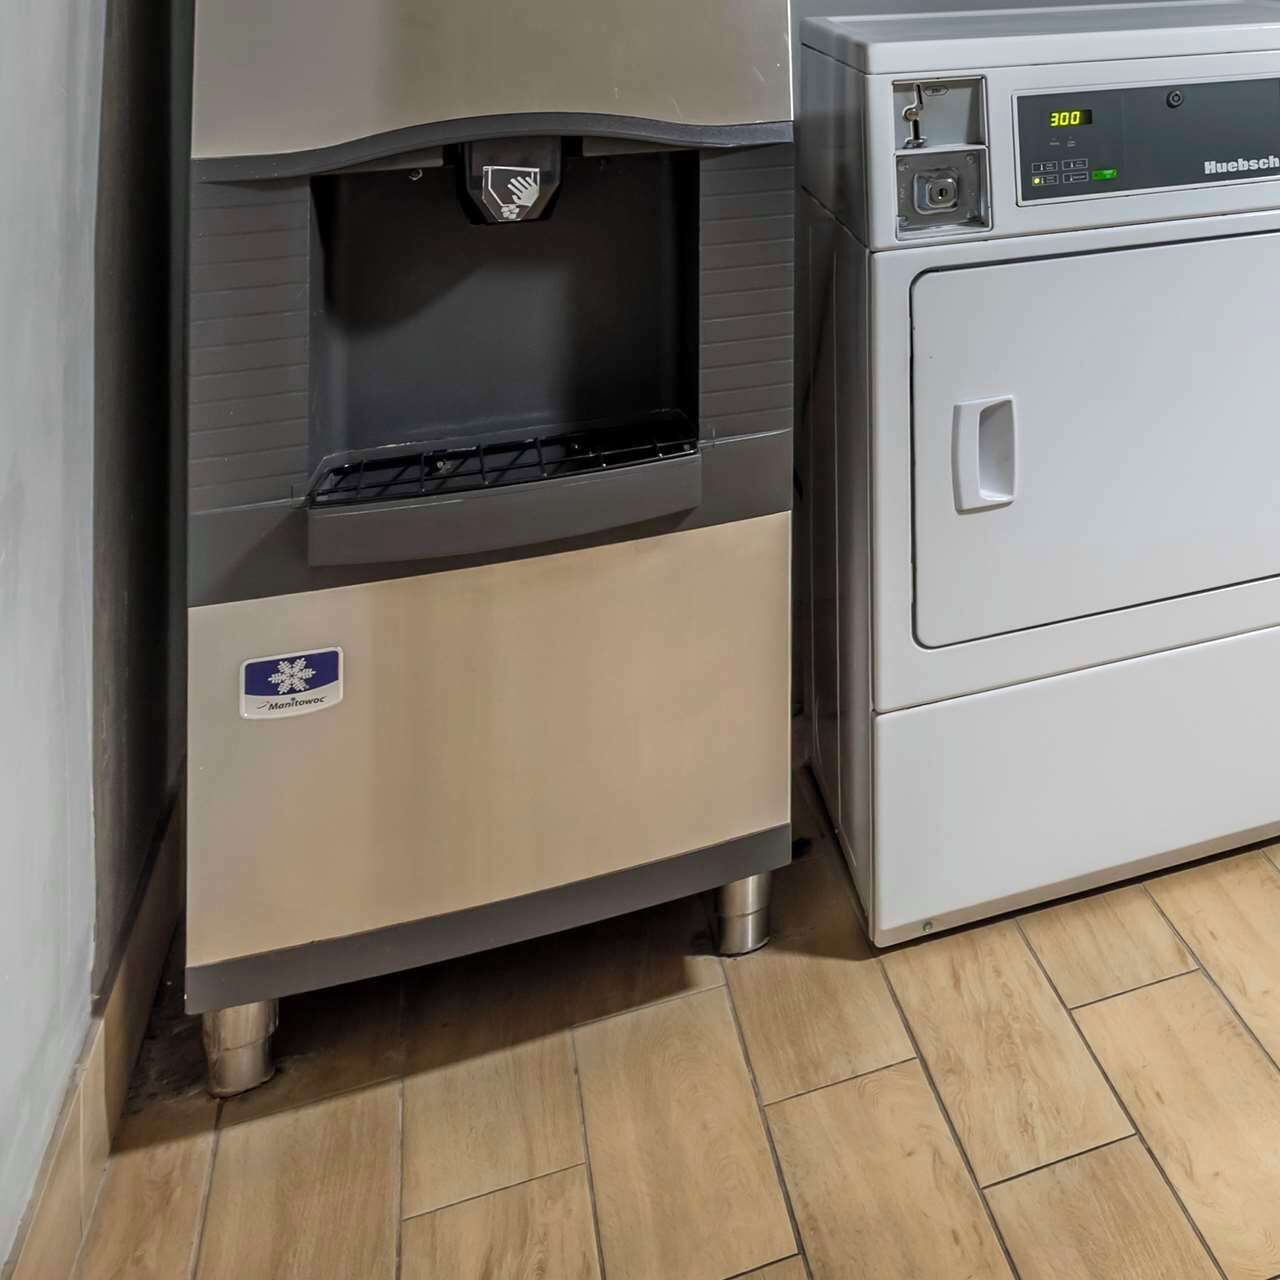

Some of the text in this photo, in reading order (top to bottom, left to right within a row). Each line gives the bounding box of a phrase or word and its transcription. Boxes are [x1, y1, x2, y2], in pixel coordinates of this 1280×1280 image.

[1050, 111, 1081, 127] 300
[1204, 155, 1280, 175] Huebsch
[268, 697, 327, 711] Manitowoc
